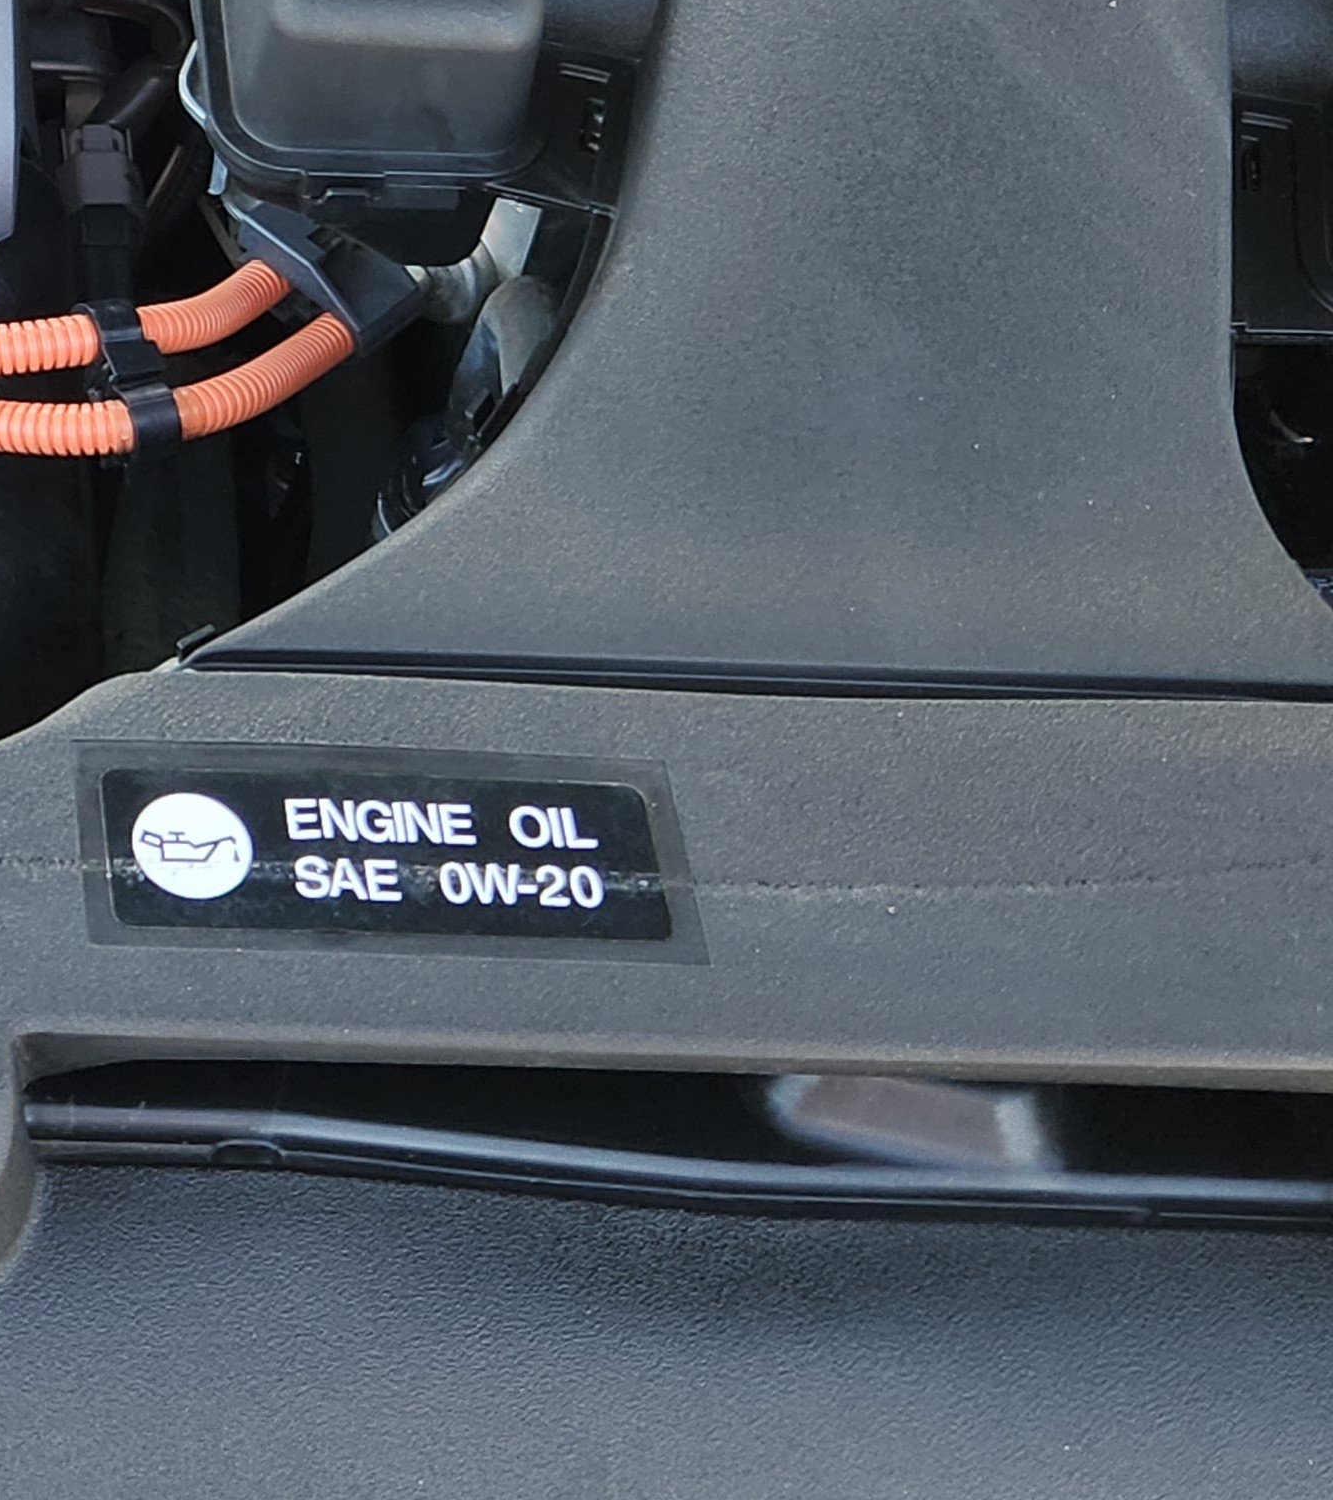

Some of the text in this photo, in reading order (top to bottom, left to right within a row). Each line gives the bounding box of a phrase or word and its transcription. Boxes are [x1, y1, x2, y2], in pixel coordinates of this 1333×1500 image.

[284, 797, 599, 850] ENGINE OIL
[293, 856, 605, 910] SAE 0W-20
